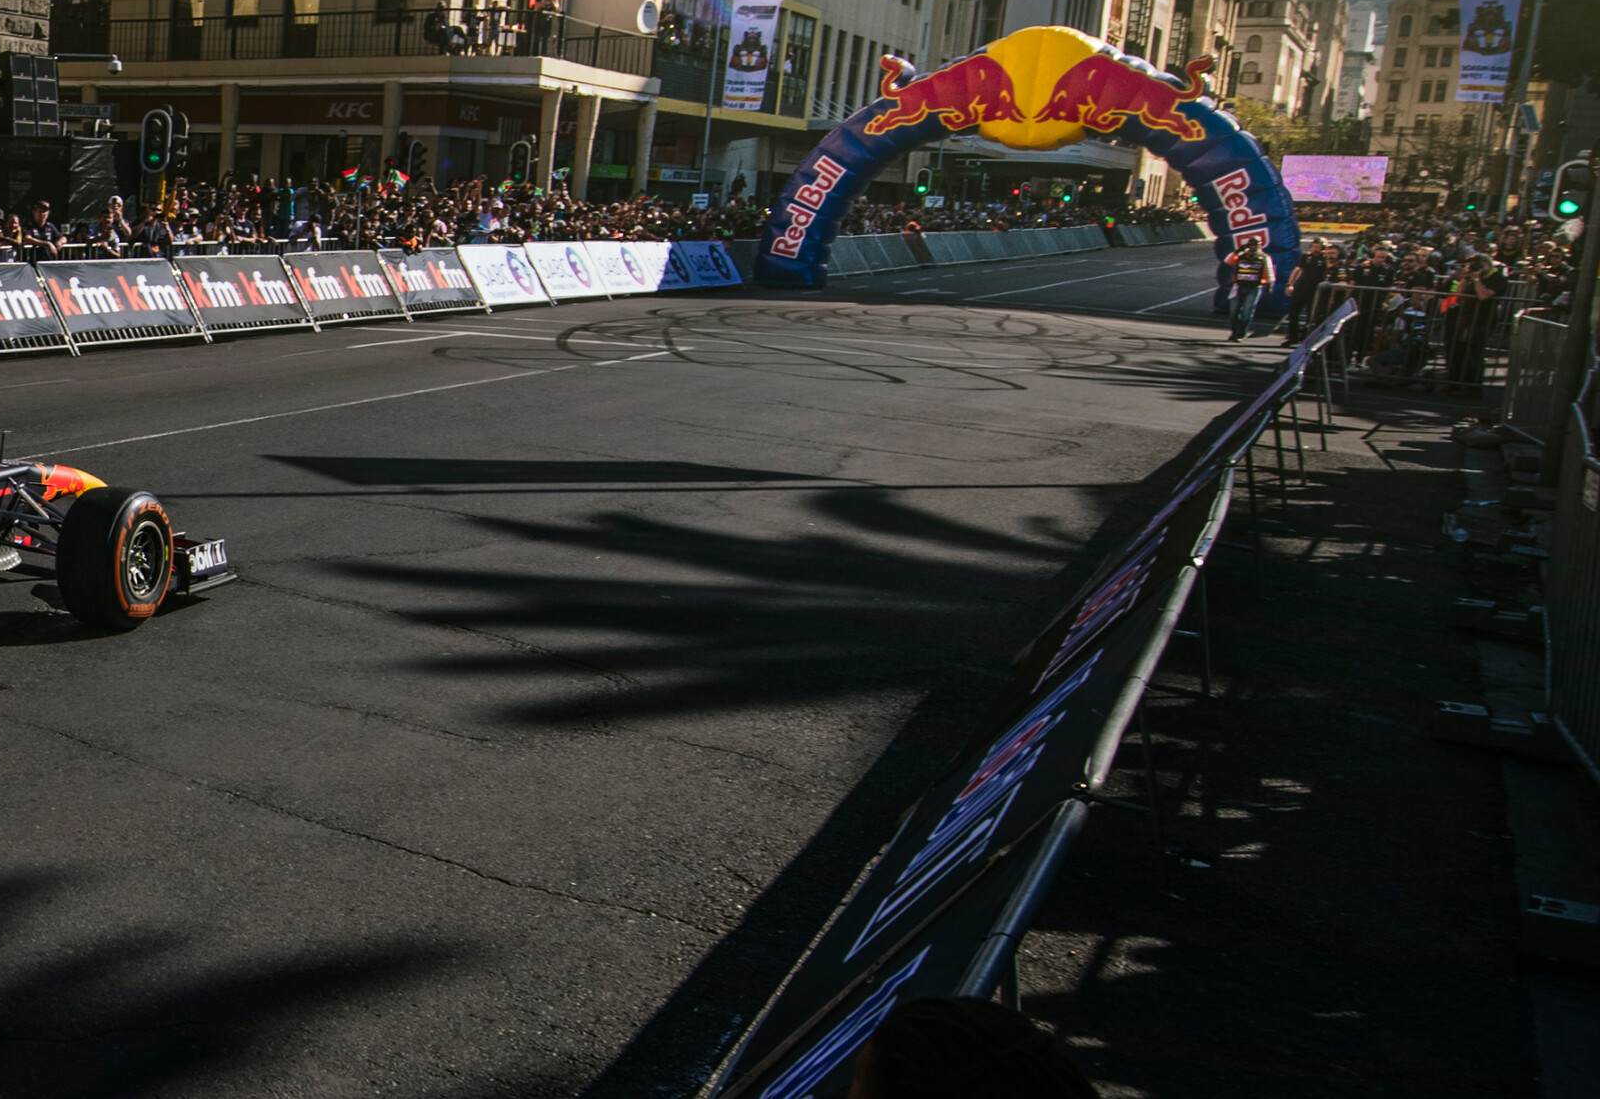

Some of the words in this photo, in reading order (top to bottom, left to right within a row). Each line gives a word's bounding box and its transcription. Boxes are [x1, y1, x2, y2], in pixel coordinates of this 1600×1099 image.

[326, 102, 373, 118] KFC
[460, 104, 480, 122] KFC
[559, 120, 577, 134] KF
[48, 276, 120, 316] kfm
[117, 274, 184, 311] kfm
[183, 271, 243, 308] kfm
[238, 271, 295, 305] kfm
[294, 267, 345, 301] kfm
[340, 265, 390, 298] kfm
[139, 501, 169, 525] ZERO
[189, 542, 214, 573] obil
